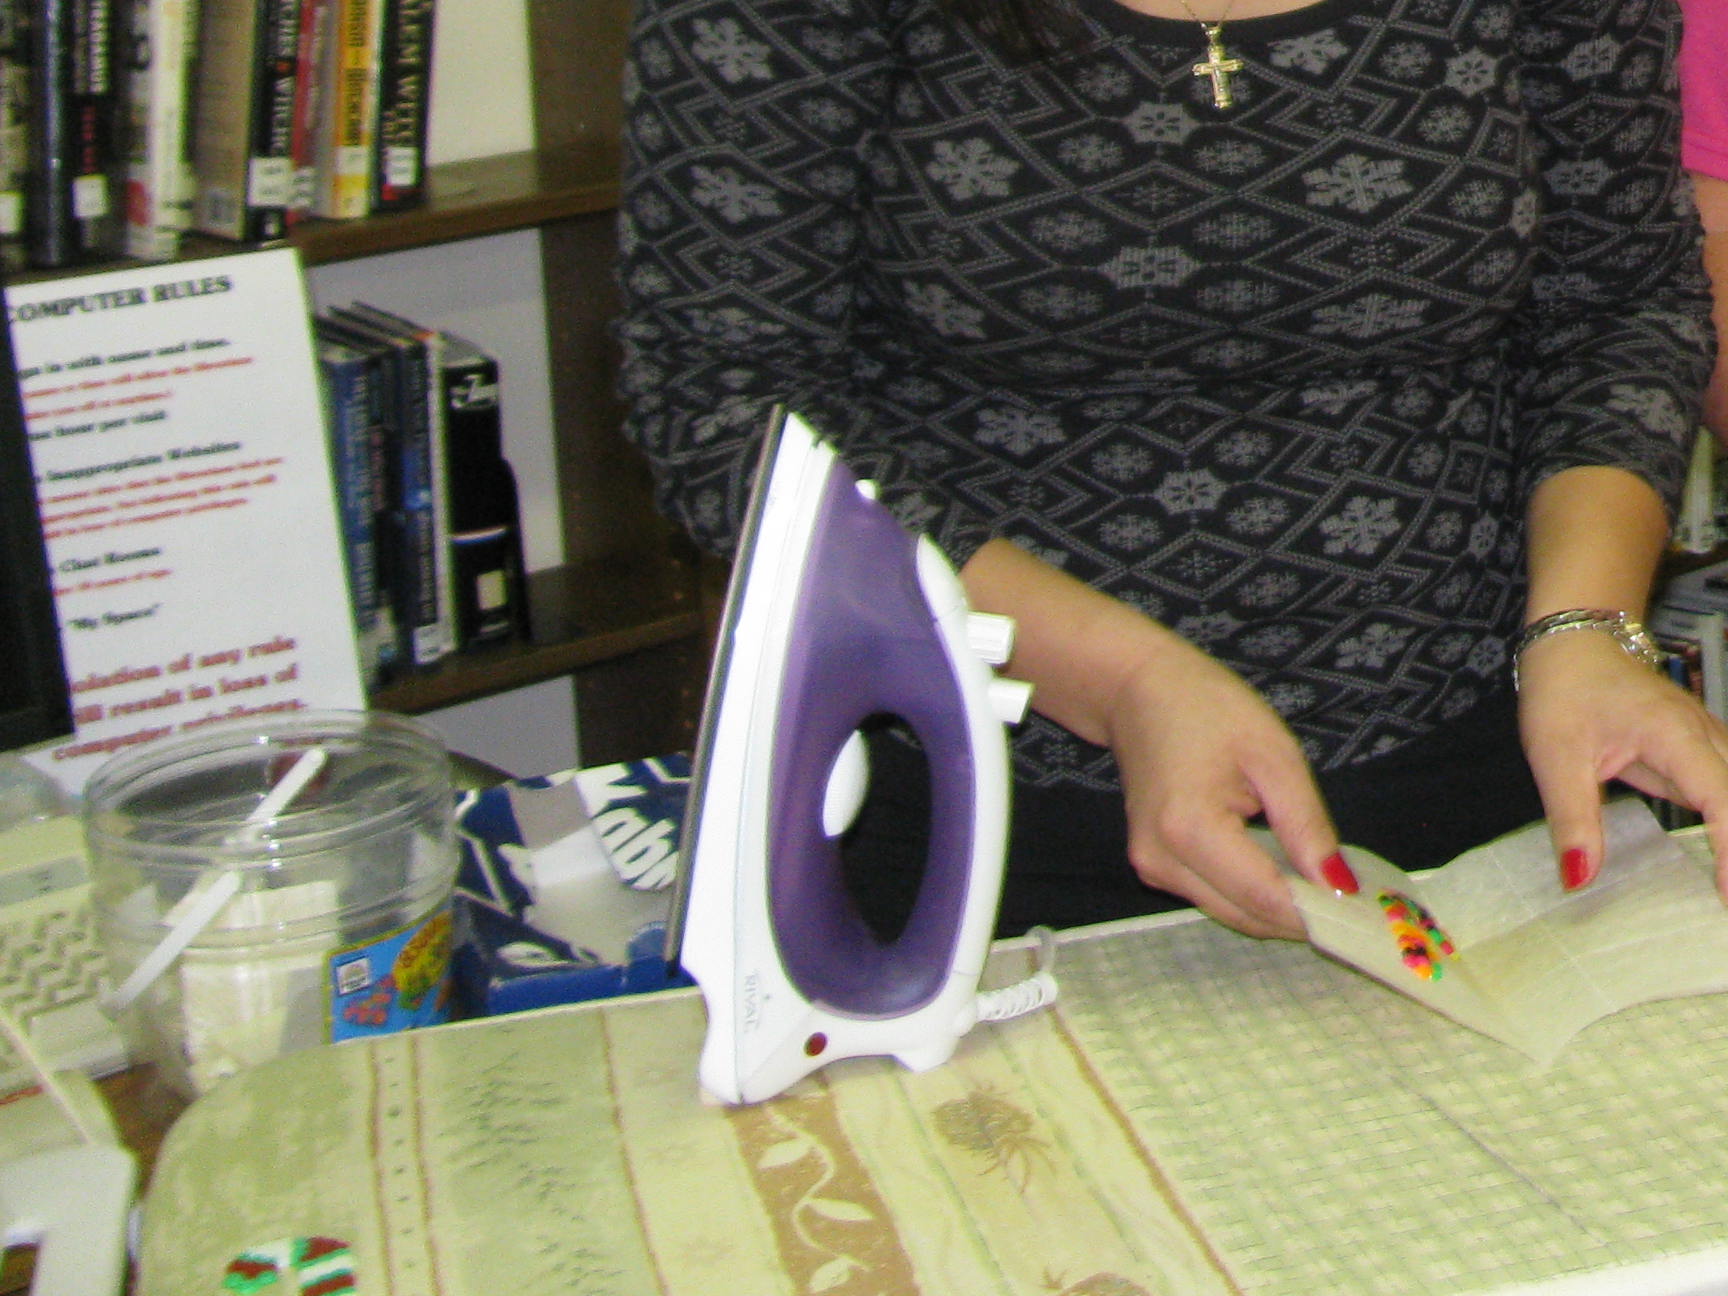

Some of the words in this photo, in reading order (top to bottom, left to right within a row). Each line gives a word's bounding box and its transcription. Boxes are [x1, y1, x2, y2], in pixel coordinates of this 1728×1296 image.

[151, 274, 233, 303] RULES
[71, 665, 162, 694] olation
[199, 649, 241, 667] any
[248, 636, 296, 657] rule
[110, 689, 182, 716] result
